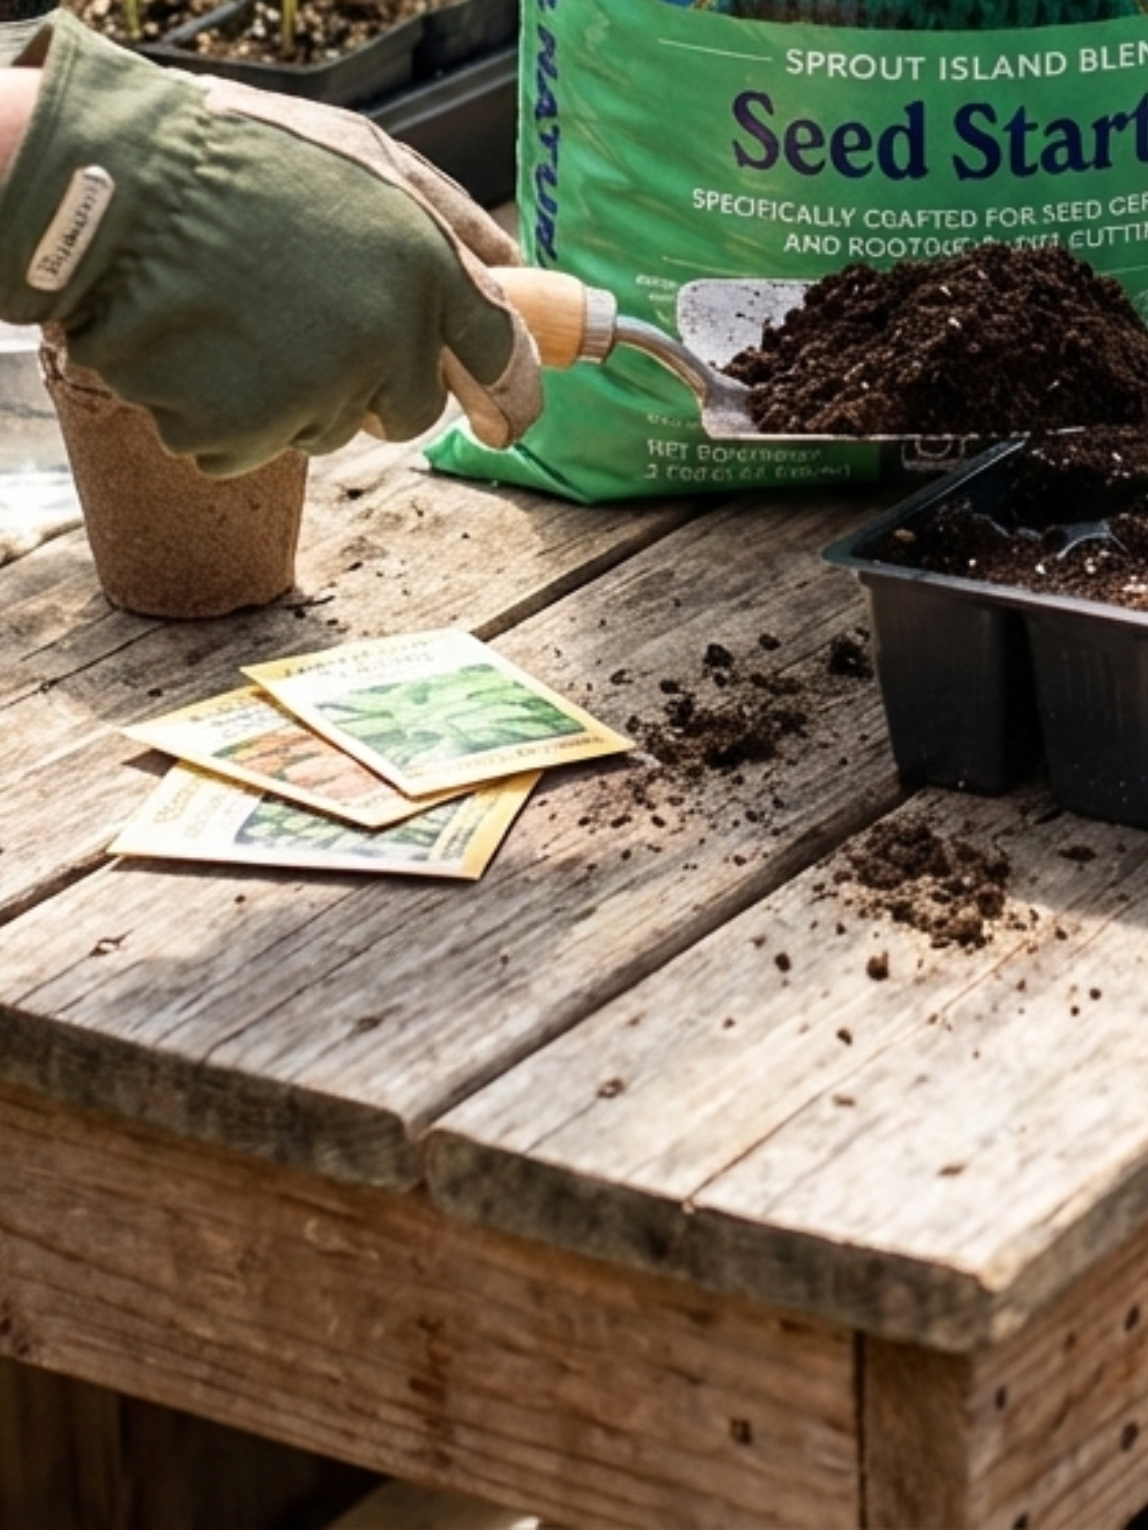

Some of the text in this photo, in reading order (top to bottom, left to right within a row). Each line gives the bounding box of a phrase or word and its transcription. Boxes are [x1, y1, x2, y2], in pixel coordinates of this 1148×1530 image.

[786, 49, 926, 81] SPROUT
[939, 51, 1067, 81] ISLAND
[731, 90, 927, 180] Seed
[985, 206, 1037, 228] FOR
[1042, 199, 1102, 225] SEED
[783, 232, 840, 255] AND
